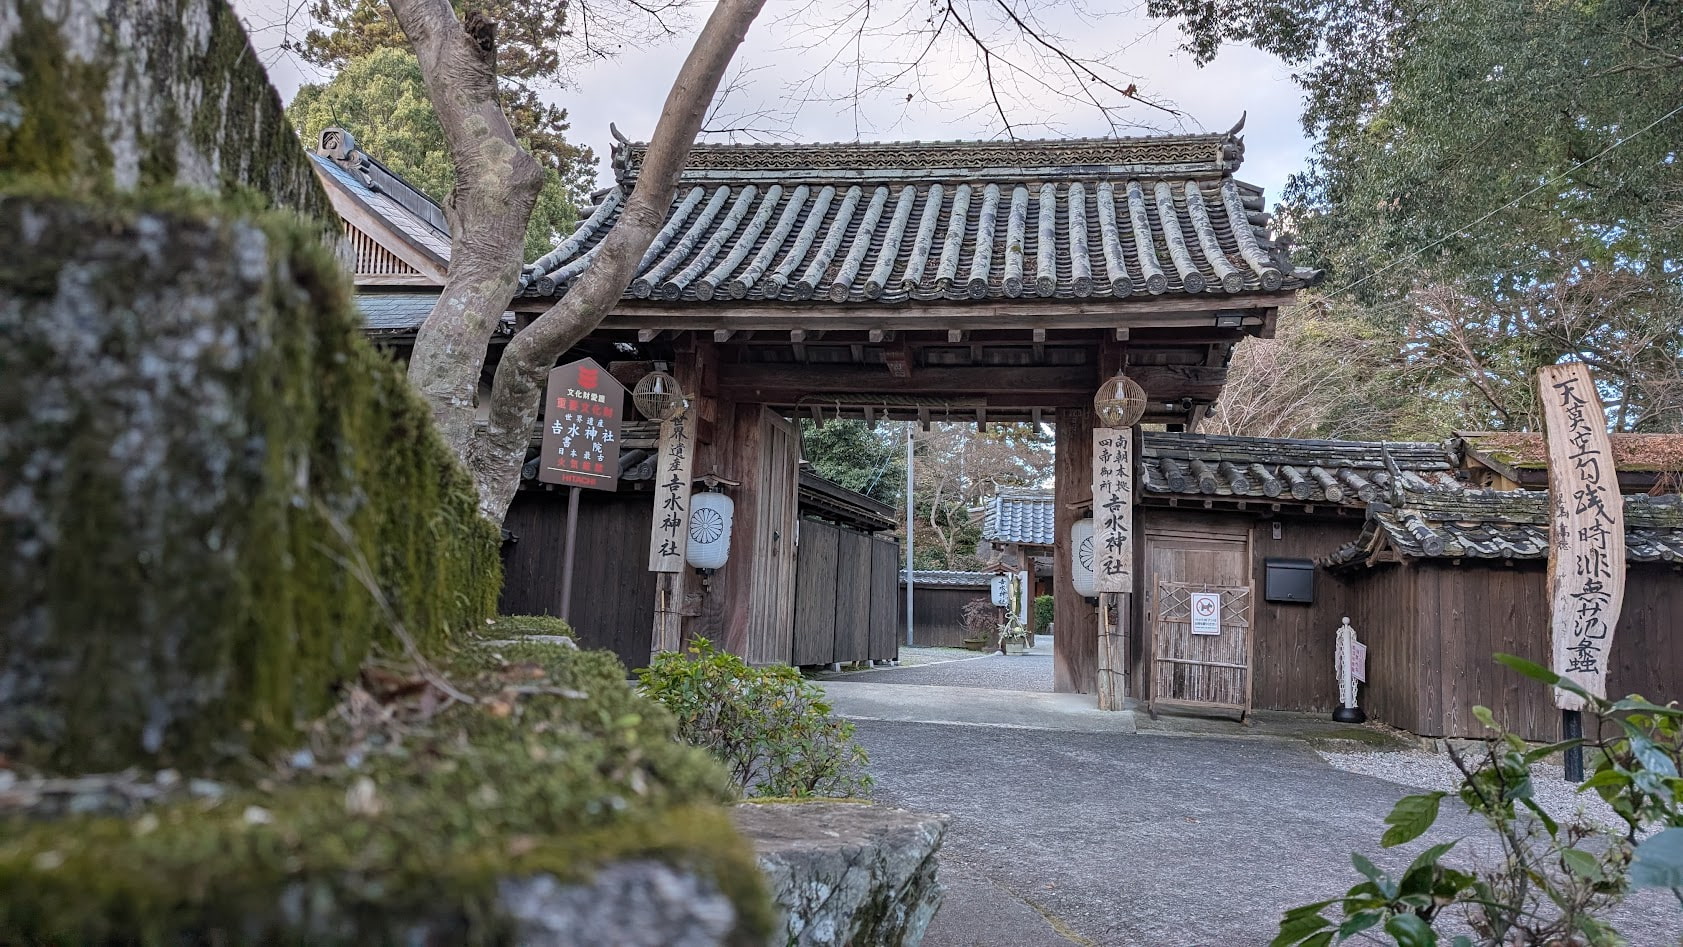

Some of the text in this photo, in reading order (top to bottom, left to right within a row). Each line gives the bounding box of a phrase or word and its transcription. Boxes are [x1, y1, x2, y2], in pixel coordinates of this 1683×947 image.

[564, 413, 604, 428] 世界遺産
[551, 420, 615, 443] 吉水神社
[558, 447, 605, 462] 日本最古
[561, 474, 597, 485] HITACHI
